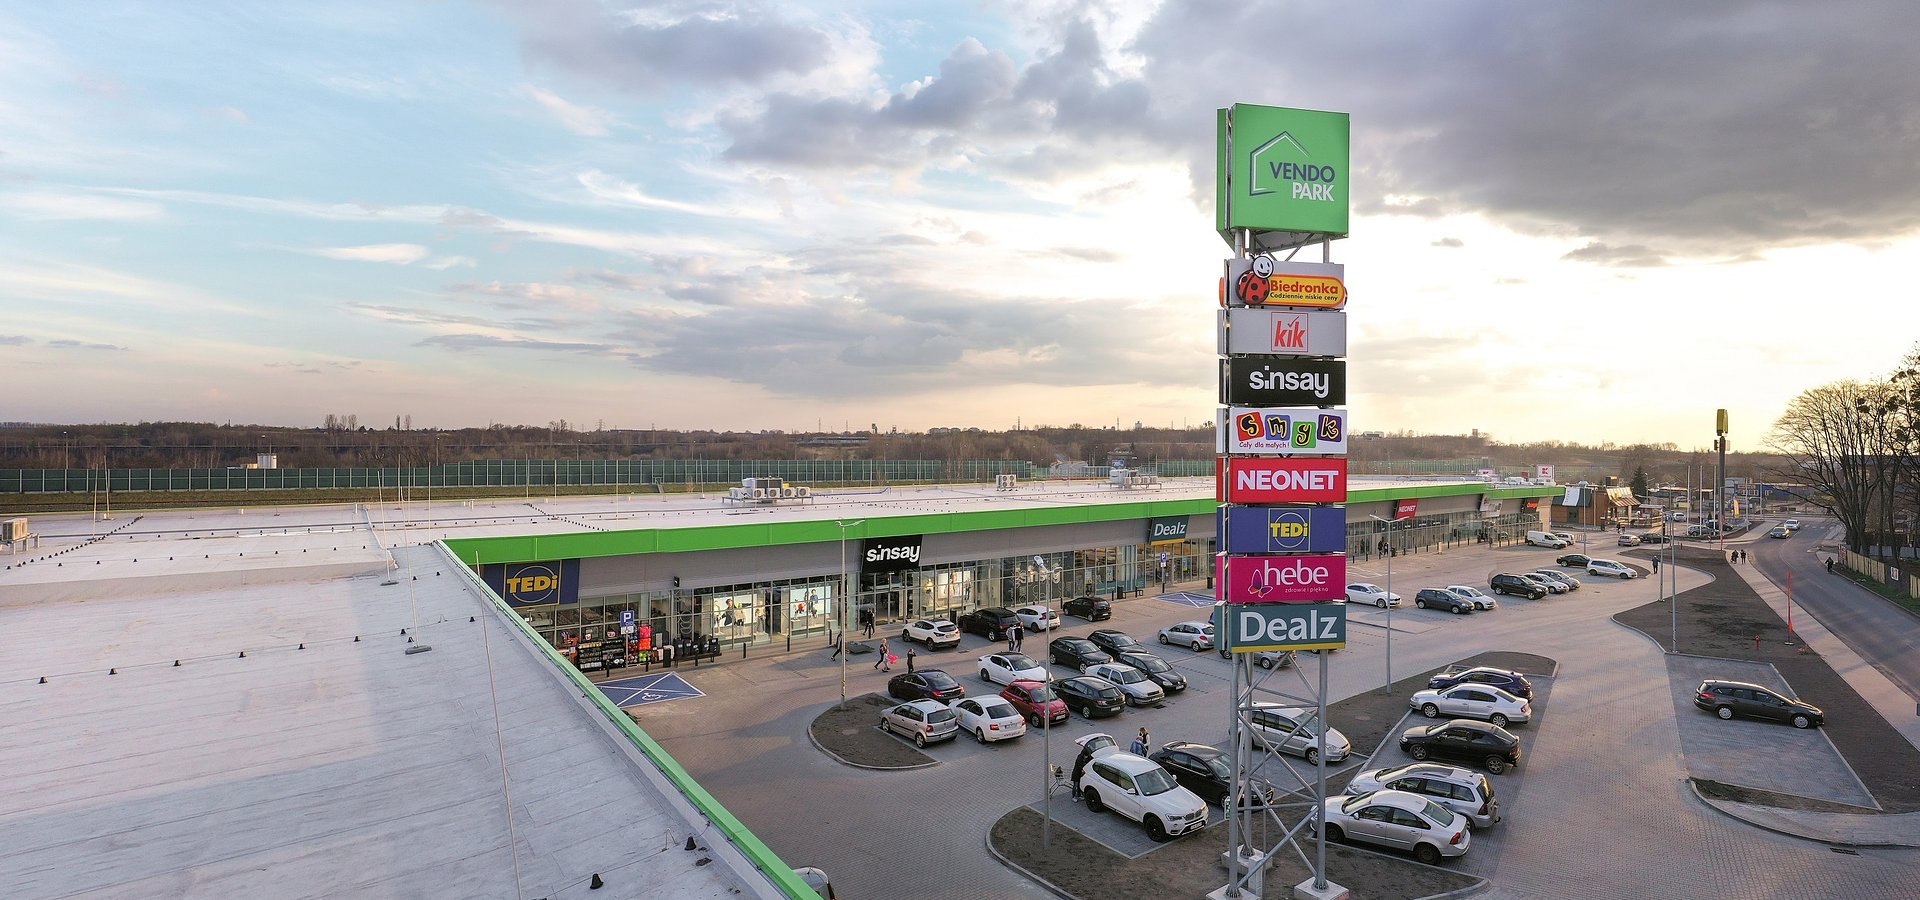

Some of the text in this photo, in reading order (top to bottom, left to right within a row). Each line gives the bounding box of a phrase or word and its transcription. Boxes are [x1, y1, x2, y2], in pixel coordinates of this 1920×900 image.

[1269, 161, 1335, 183] VENDO
[1292, 182, 1334, 202] PARK
[1270, 279, 1339, 295] Biedronka
[1270, 291, 1303, 300] Codziennie
[1274, 318, 1305, 348] kik
[1248, 365, 1329, 399] sinsay
[1237, 469, 1339, 491] NEONET
[1153, 521, 1187, 537] Dealz
[1270, 522, 1308, 538] TEDi
[866, 544, 921, 563] sinsay
[1264, 559, 1329, 586] hebe
[506, 574, 558, 594] TEDi
[623, 612, 632, 623] P
[1240, 609, 1338, 642] Dealz
